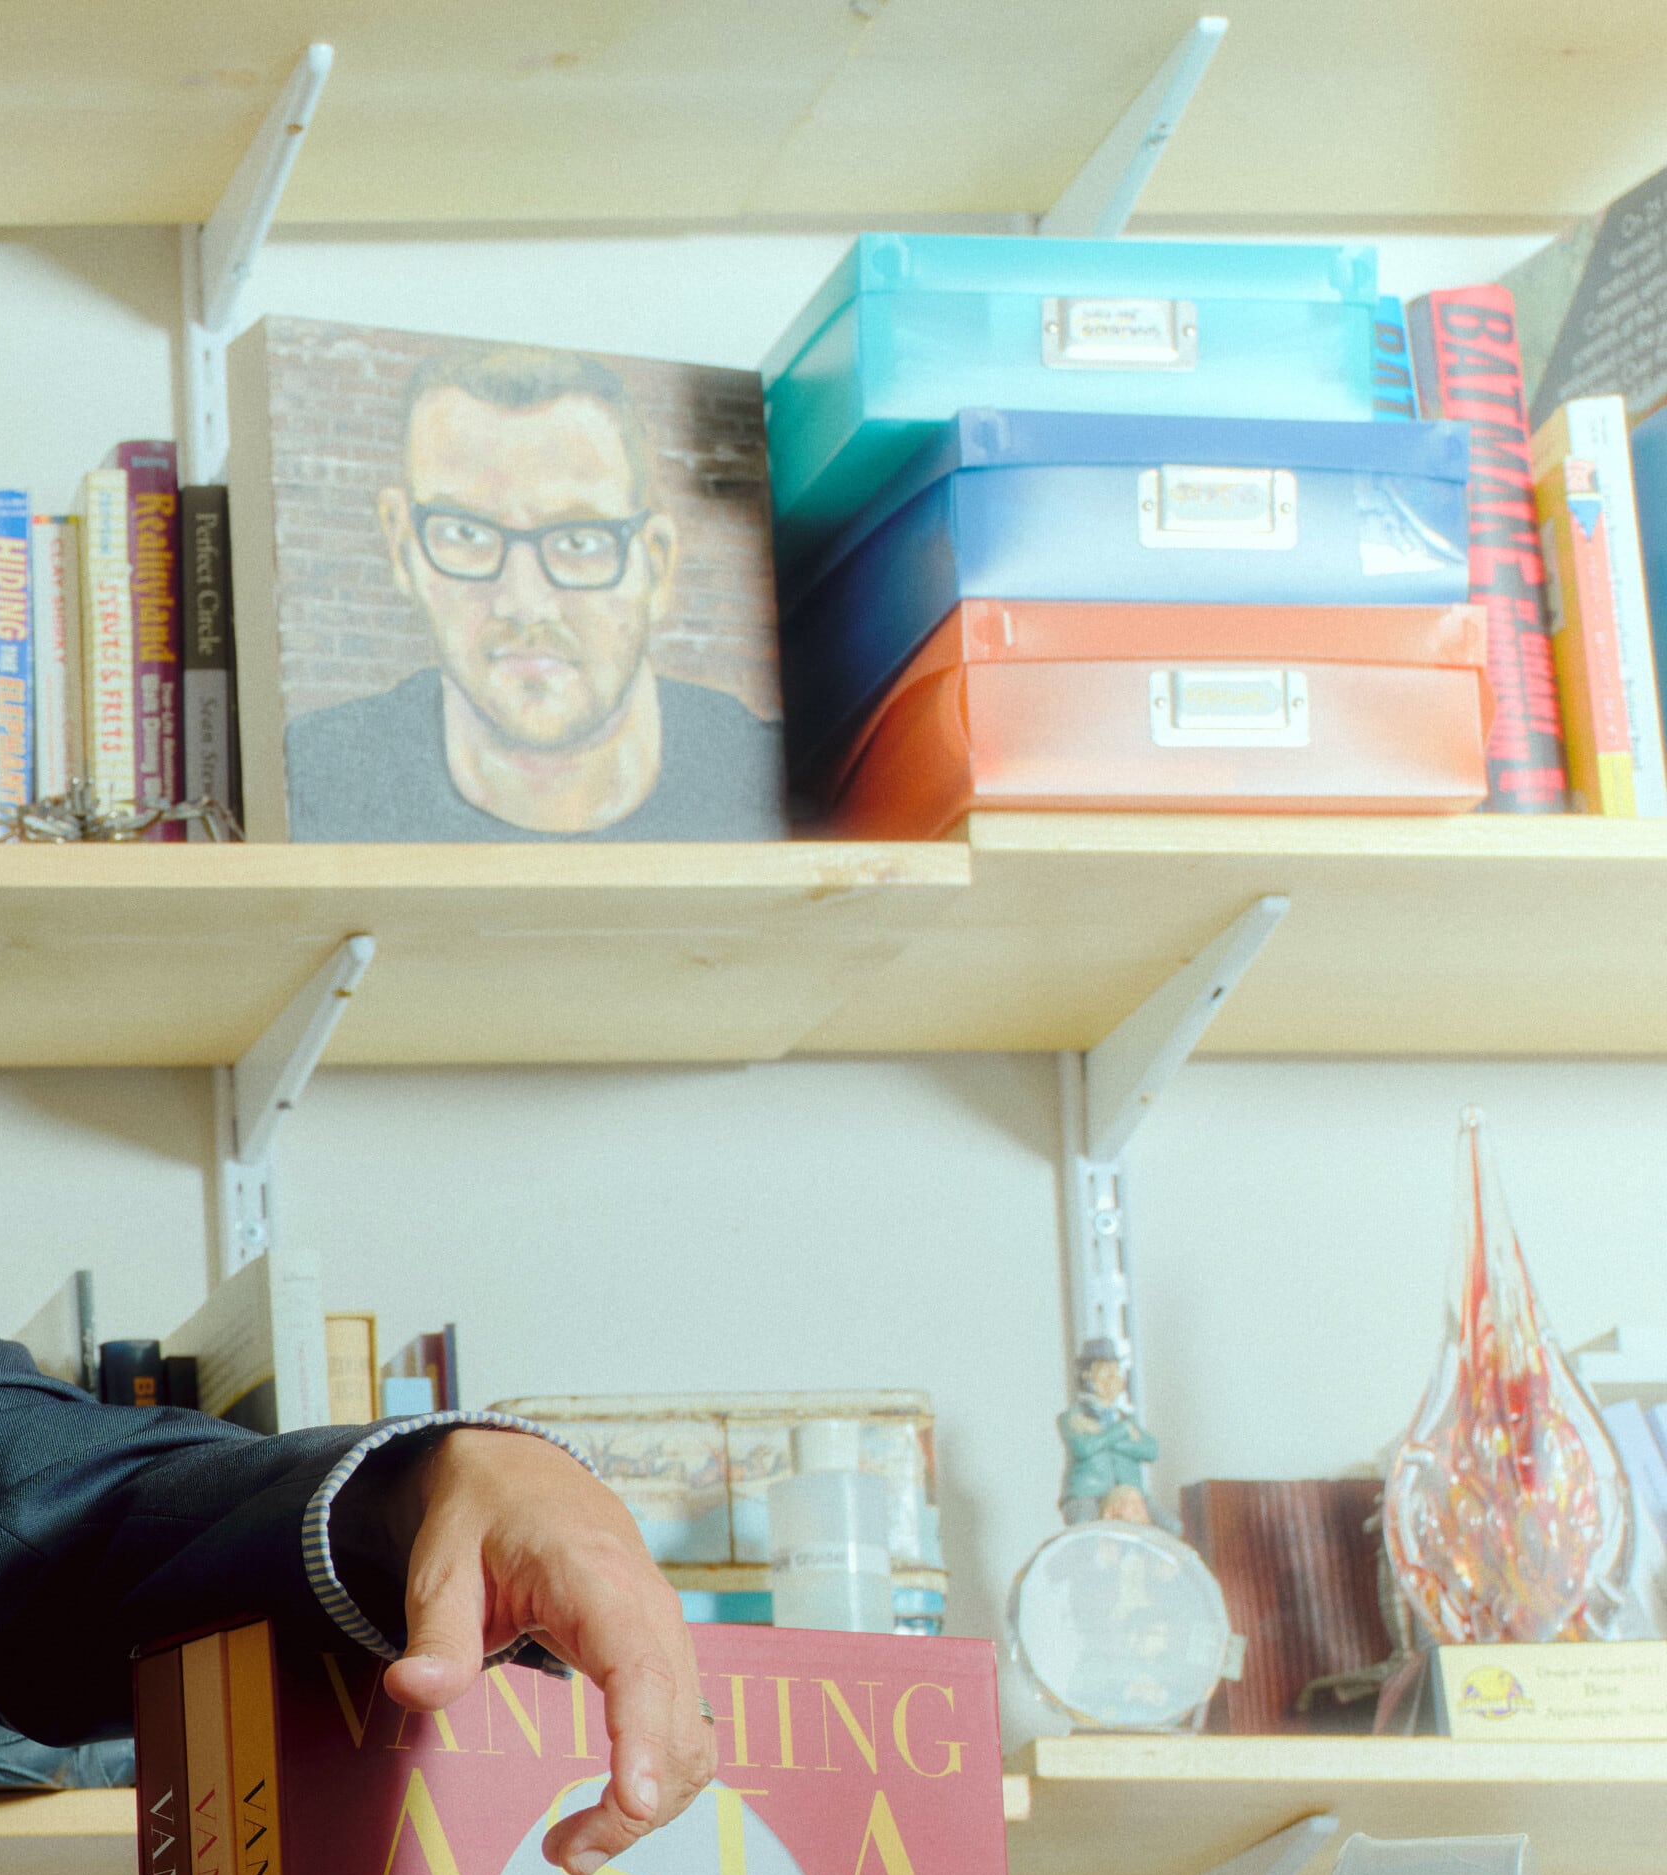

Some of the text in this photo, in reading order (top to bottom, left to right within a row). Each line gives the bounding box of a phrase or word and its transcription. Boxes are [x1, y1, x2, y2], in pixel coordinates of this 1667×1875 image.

[130, 491, 176, 664] Realityland
[194, 512, 221, 656] Perfect Circle
